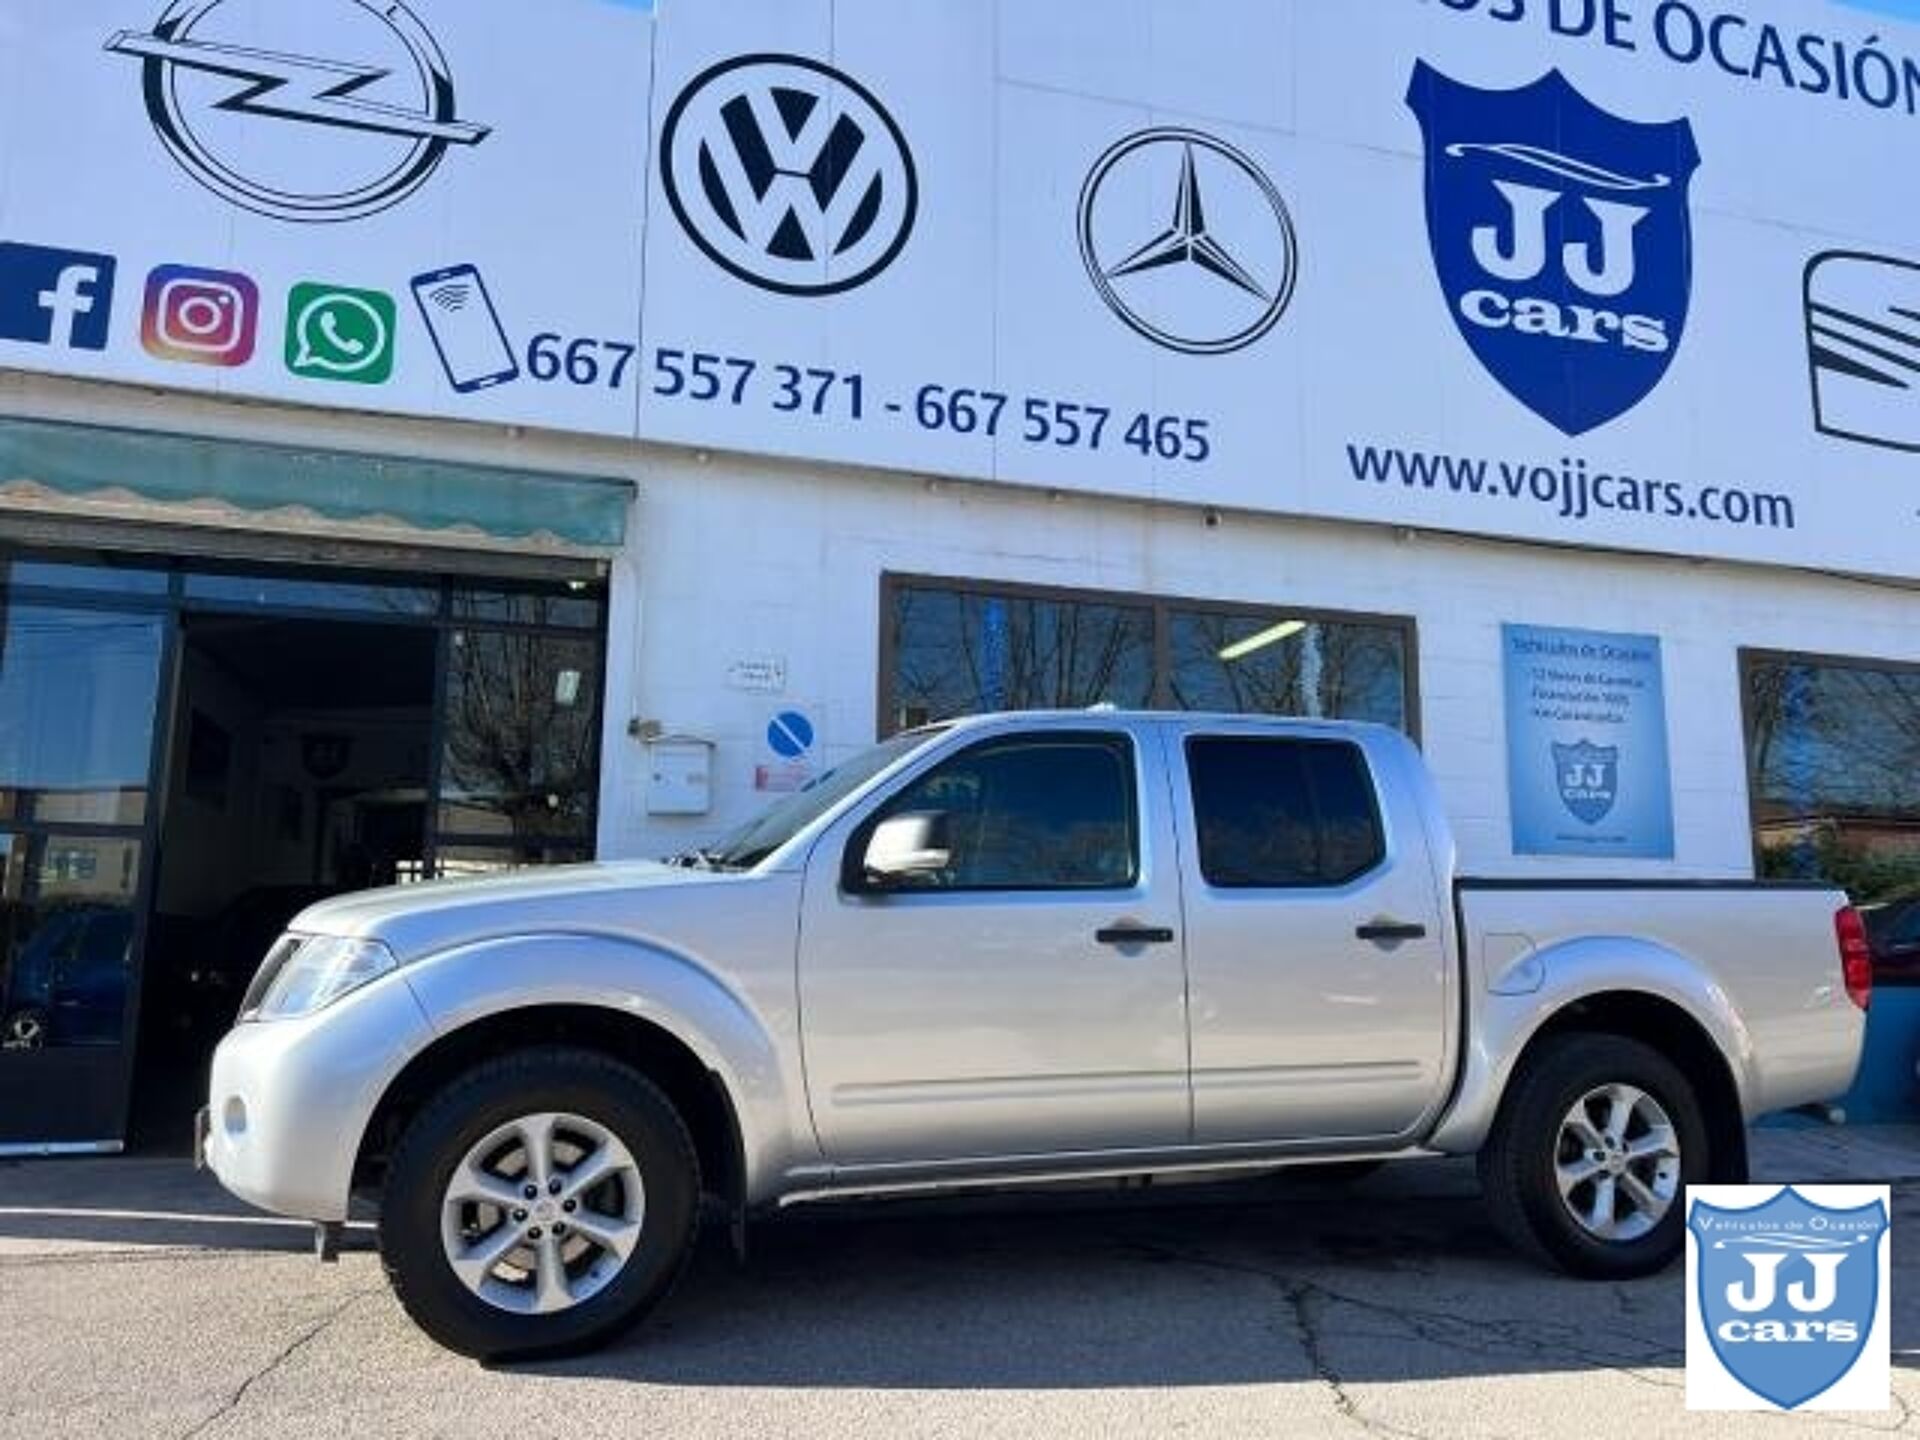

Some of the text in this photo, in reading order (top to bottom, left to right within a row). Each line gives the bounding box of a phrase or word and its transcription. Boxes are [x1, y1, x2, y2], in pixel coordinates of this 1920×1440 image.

[1551, 0, 1636, 50] DE
[1472, 179, 1651, 297] JJ
[1460, 290, 1669, 353] cars
[527, 332, 636, 388] 667
[653, 348, 756, 404] 557
[773, 365, 862, 419] 371
[916, 385, 1007, 436] 667
[1024, 398, 1110, 450] 557
[1124, 412, 1209, 462] 465
[1347, 444, 1795, 529] www.vojjcars.com
[1565, 764, 1606, 787] JJ
